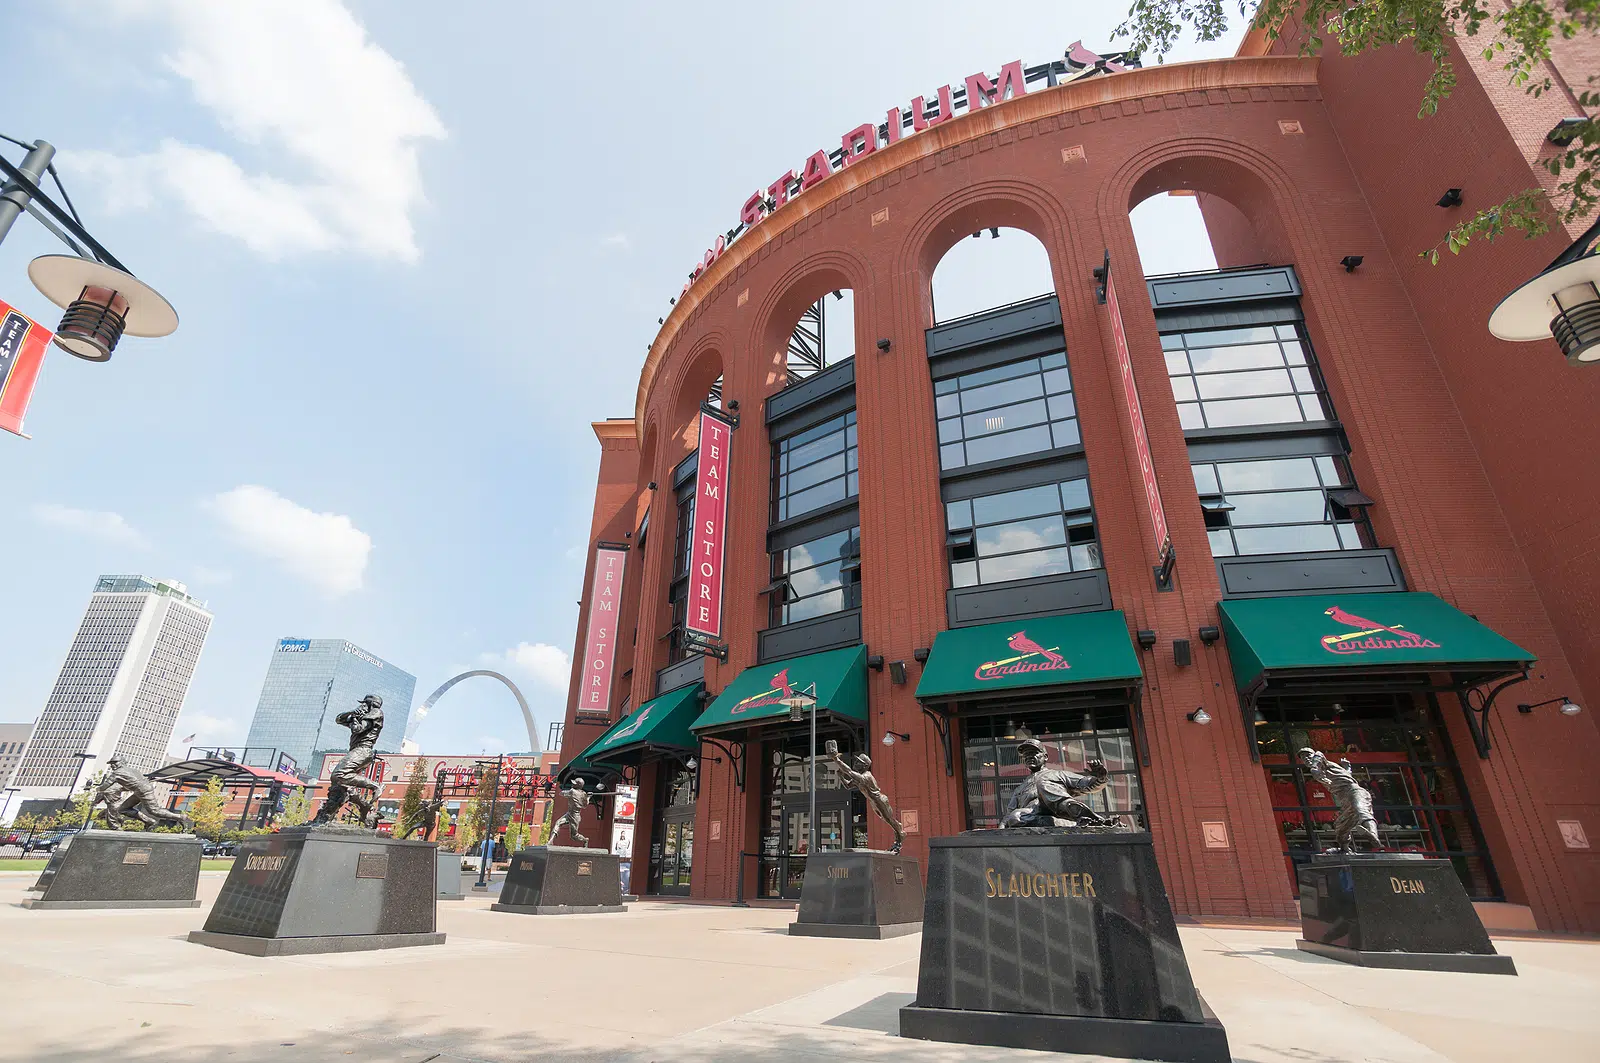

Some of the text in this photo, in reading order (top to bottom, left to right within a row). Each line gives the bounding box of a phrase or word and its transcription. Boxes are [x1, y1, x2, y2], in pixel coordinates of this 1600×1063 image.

[740, 59, 1027, 227] STADIUM
[0, 320, 22, 359] TEAM
[698, 425, 722, 623] TEAM STORE
[590, 557, 616, 703] TEAM STORE
[278, 643, 307, 653] KPMG
[1320, 635, 1441, 655] Cardinals
[974, 659, 1071, 681] Cardinals
[731, 696, 781, 715] Cardina
[827, 865, 849, 879] SMITH
[985, 867, 1097, 898] SLAUGHTER
[1390, 876, 1426, 894] DEAN
